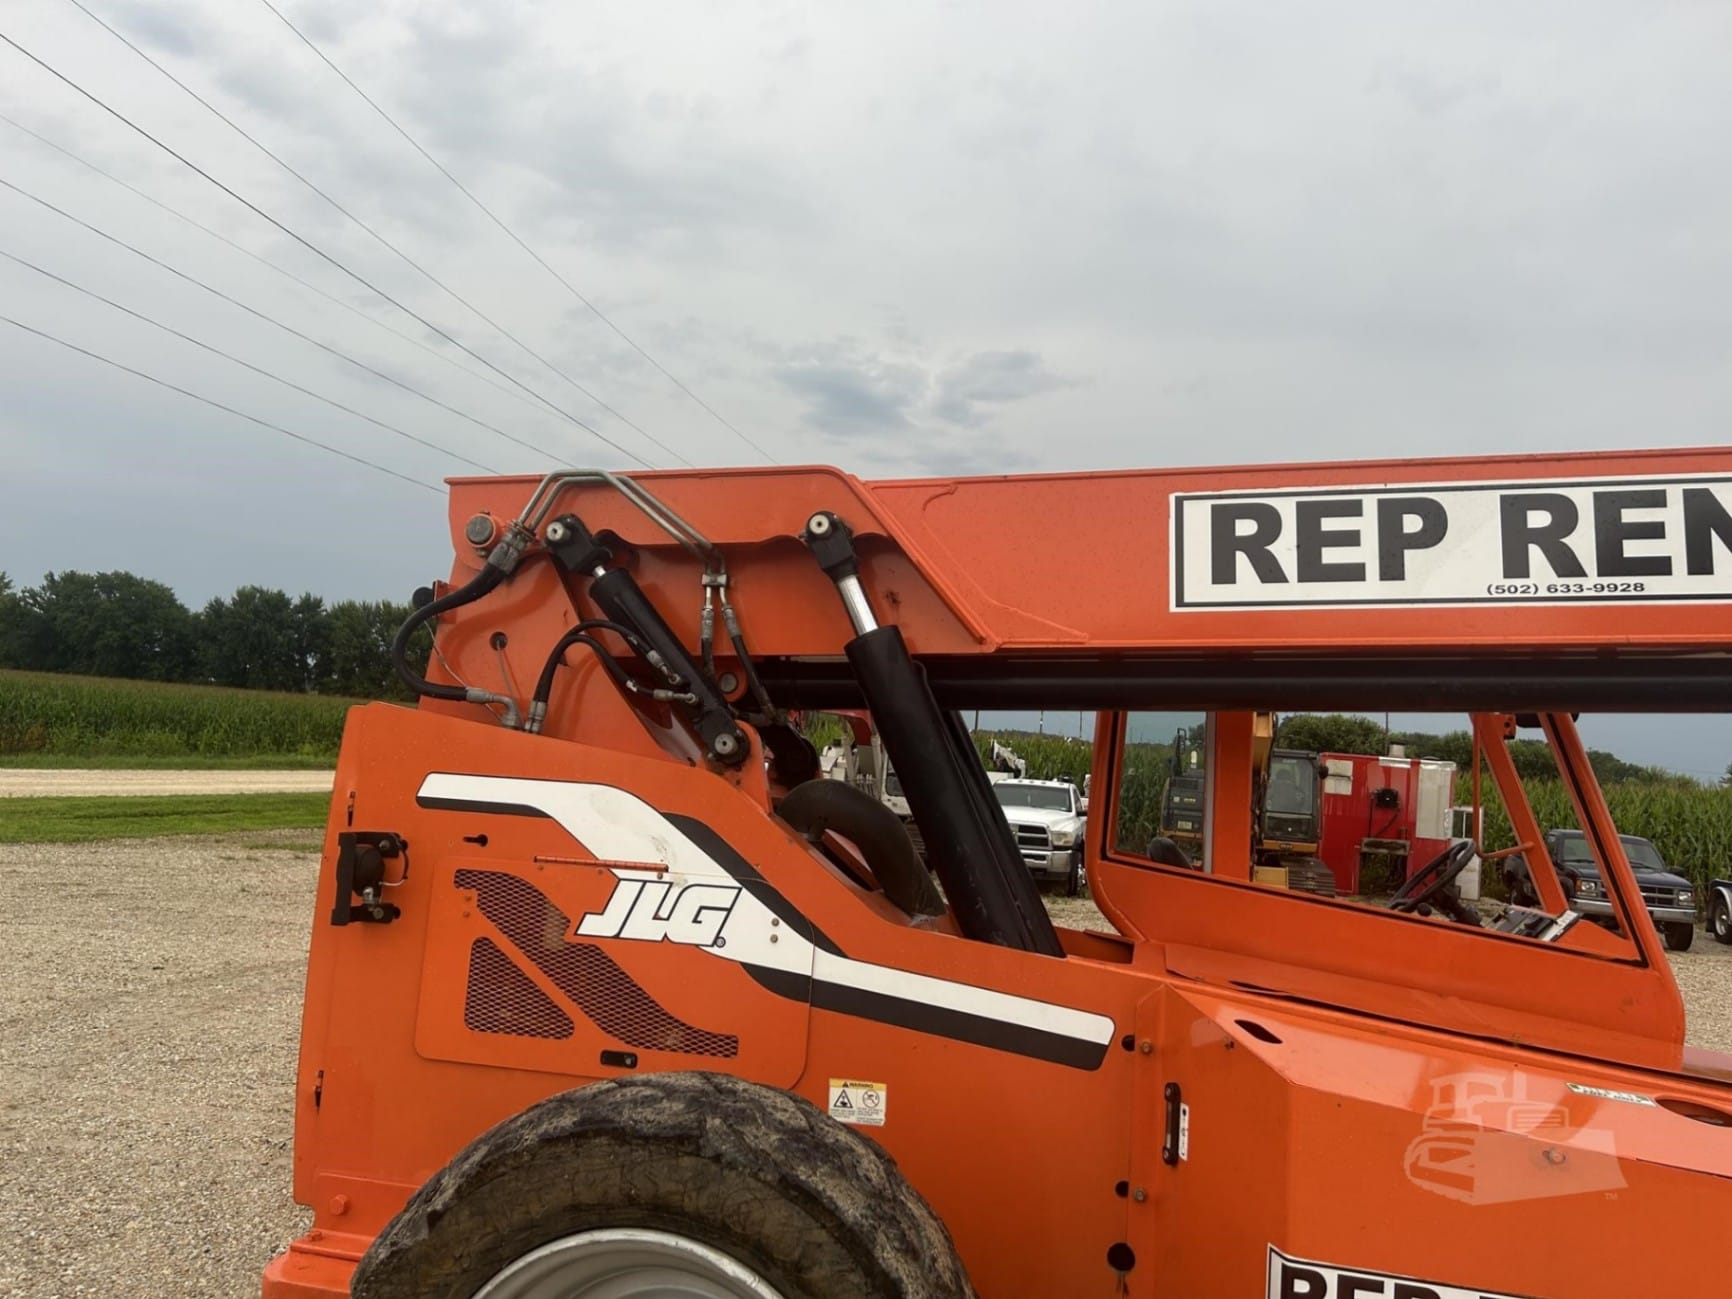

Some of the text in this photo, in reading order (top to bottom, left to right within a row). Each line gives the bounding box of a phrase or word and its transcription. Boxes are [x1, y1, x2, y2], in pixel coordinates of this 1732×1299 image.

[1210, 496, 1449, 585] REP
[1486, 581, 1646, 596] (502) 633-9928
[574, 877, 743, 948] JLG
